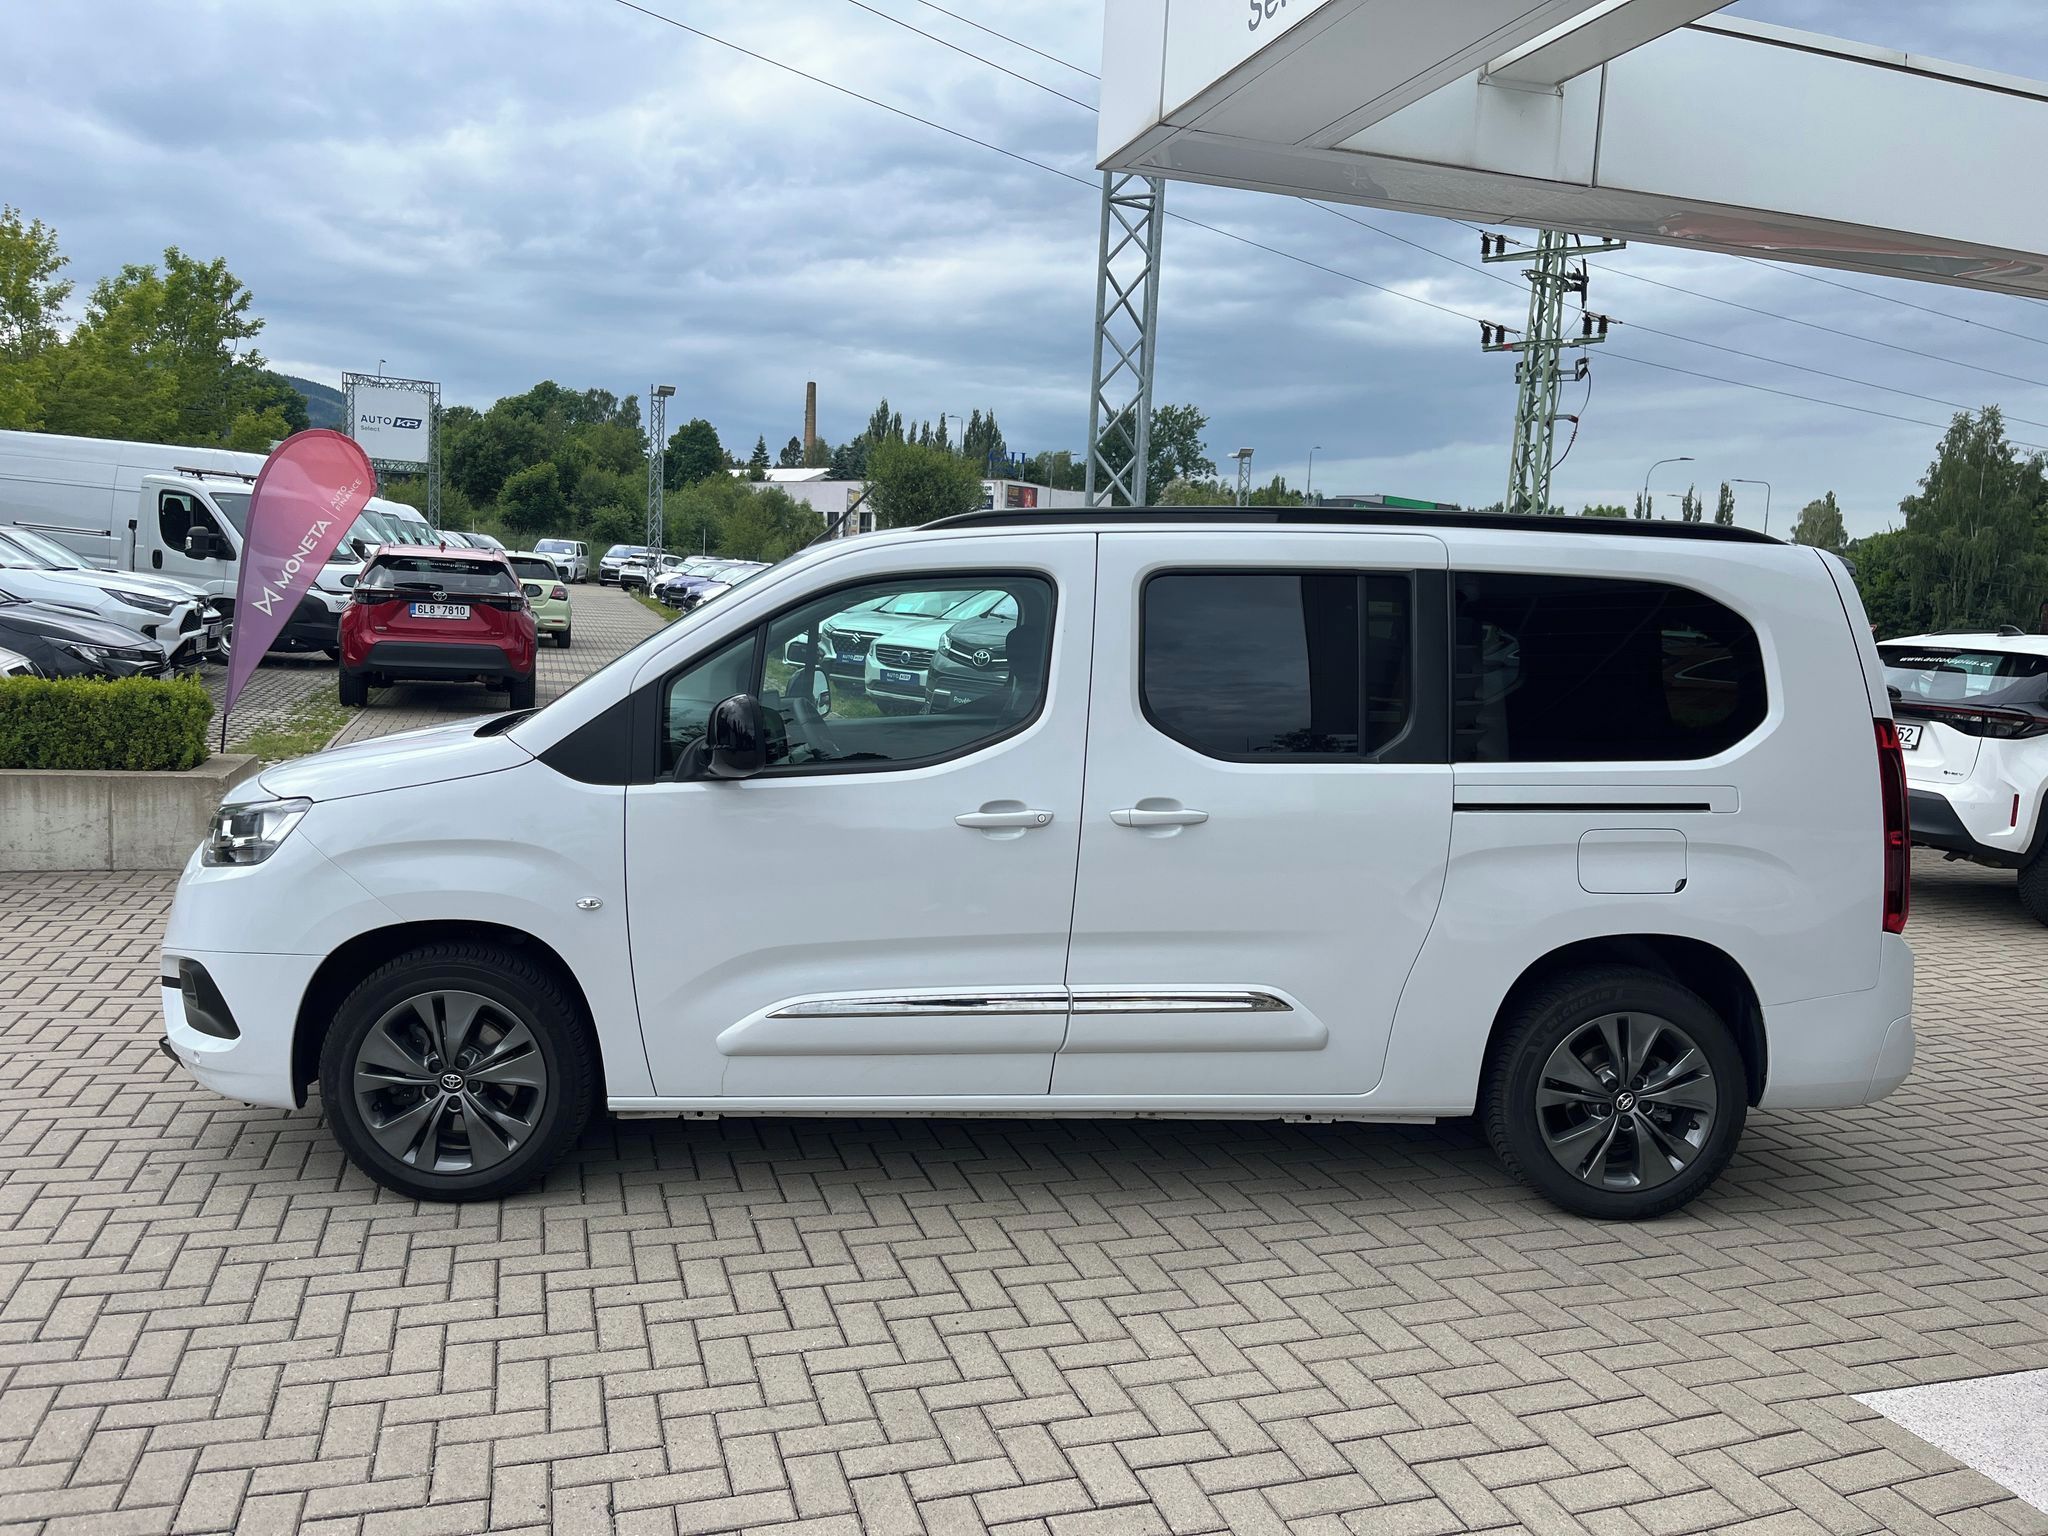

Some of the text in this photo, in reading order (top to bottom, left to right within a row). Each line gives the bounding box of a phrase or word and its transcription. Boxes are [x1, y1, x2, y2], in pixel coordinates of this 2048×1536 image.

[1248, 0, 1286, 31] Se
[361, 414, 392, 425] AUTO
[330, 485, 348, 507] AUTO
[336, 479, 363, 512] FINANCE
[274, 520, 332, 589] MONETA
[417, 604, 465, 616] 6L8 7810
